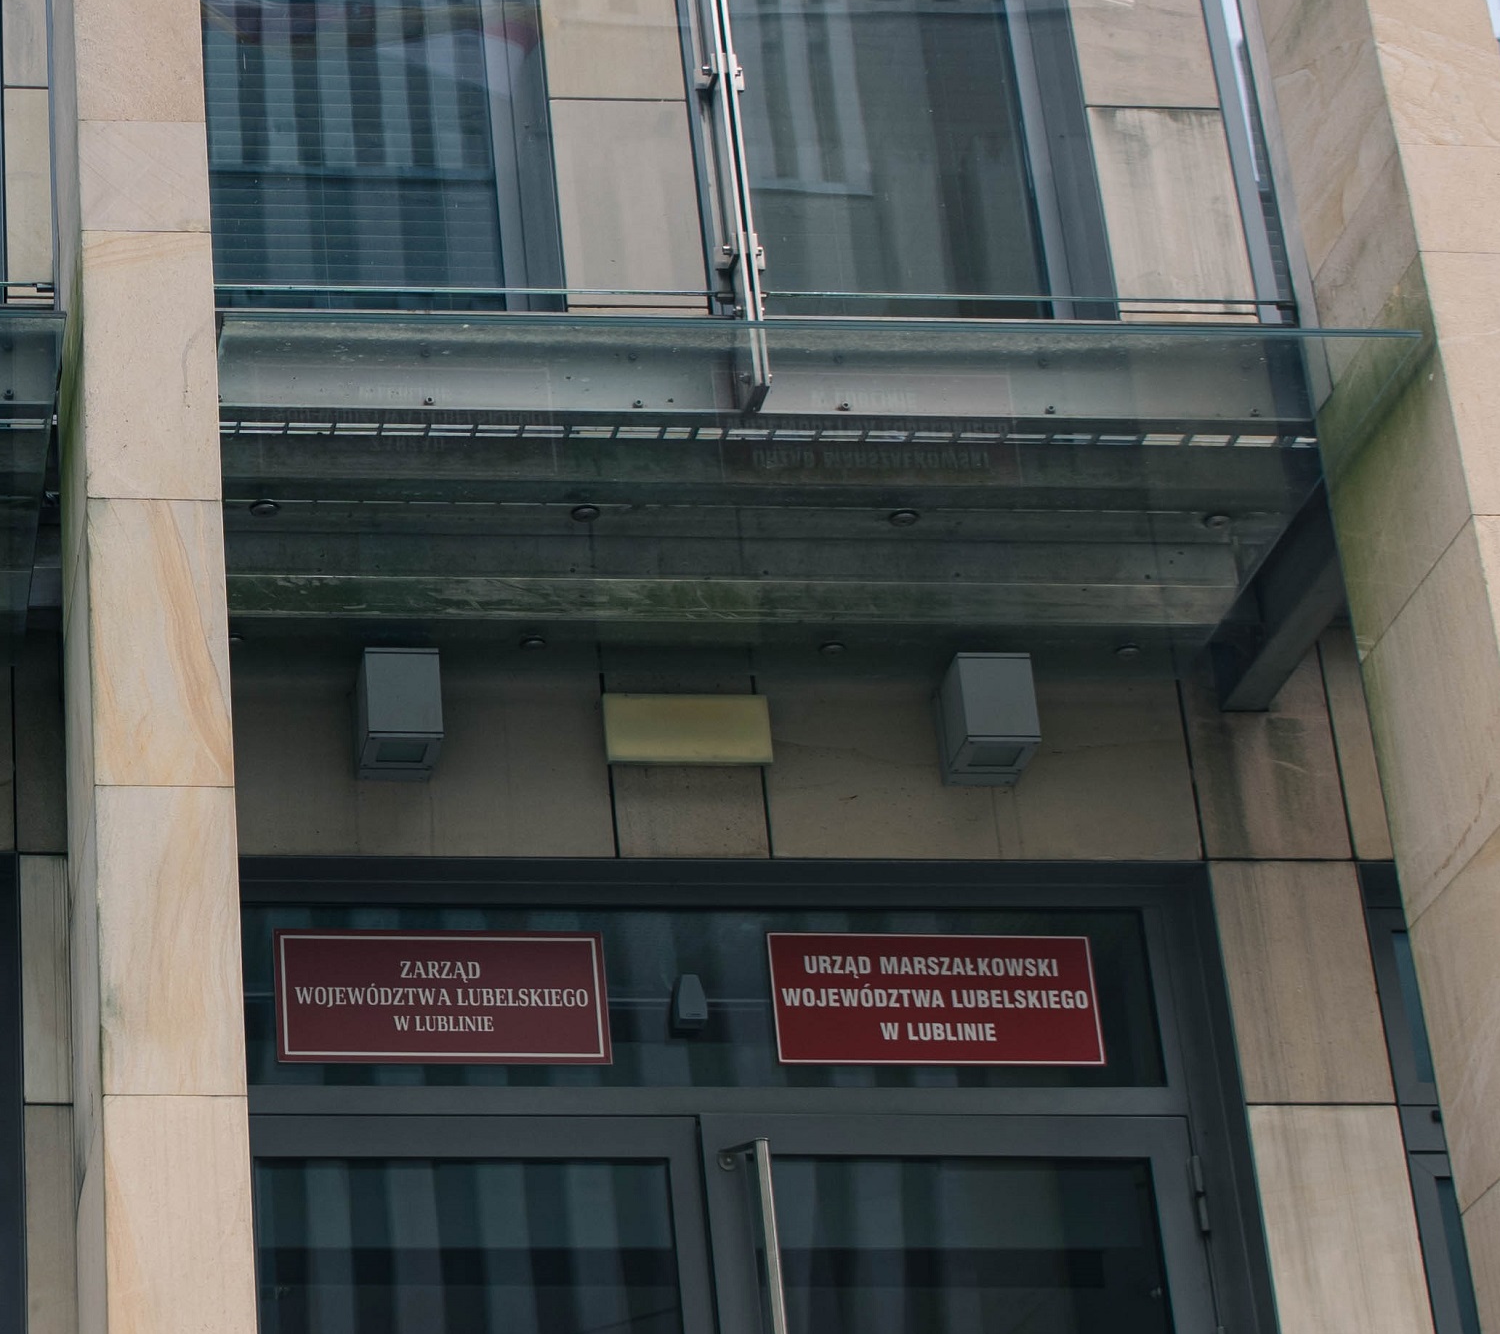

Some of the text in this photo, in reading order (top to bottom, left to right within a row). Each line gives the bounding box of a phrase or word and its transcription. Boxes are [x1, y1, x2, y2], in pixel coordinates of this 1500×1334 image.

[399, 961, 481, 983] ZARZĄD
[803, 955, 1059, 979] URZĄD MARSZAŁKOWSKI
[294, 983, 589, 1008] WOJEWÓDZTWA LUBELSKIEGO
[781, 983, 1089, 1009] WOJEWÓDZTWA LUBELSKIEGO
[393, 1015, 494, 1032] W LUBLINIE
[880, 1022, 997, 1041] W LUBLINIE
